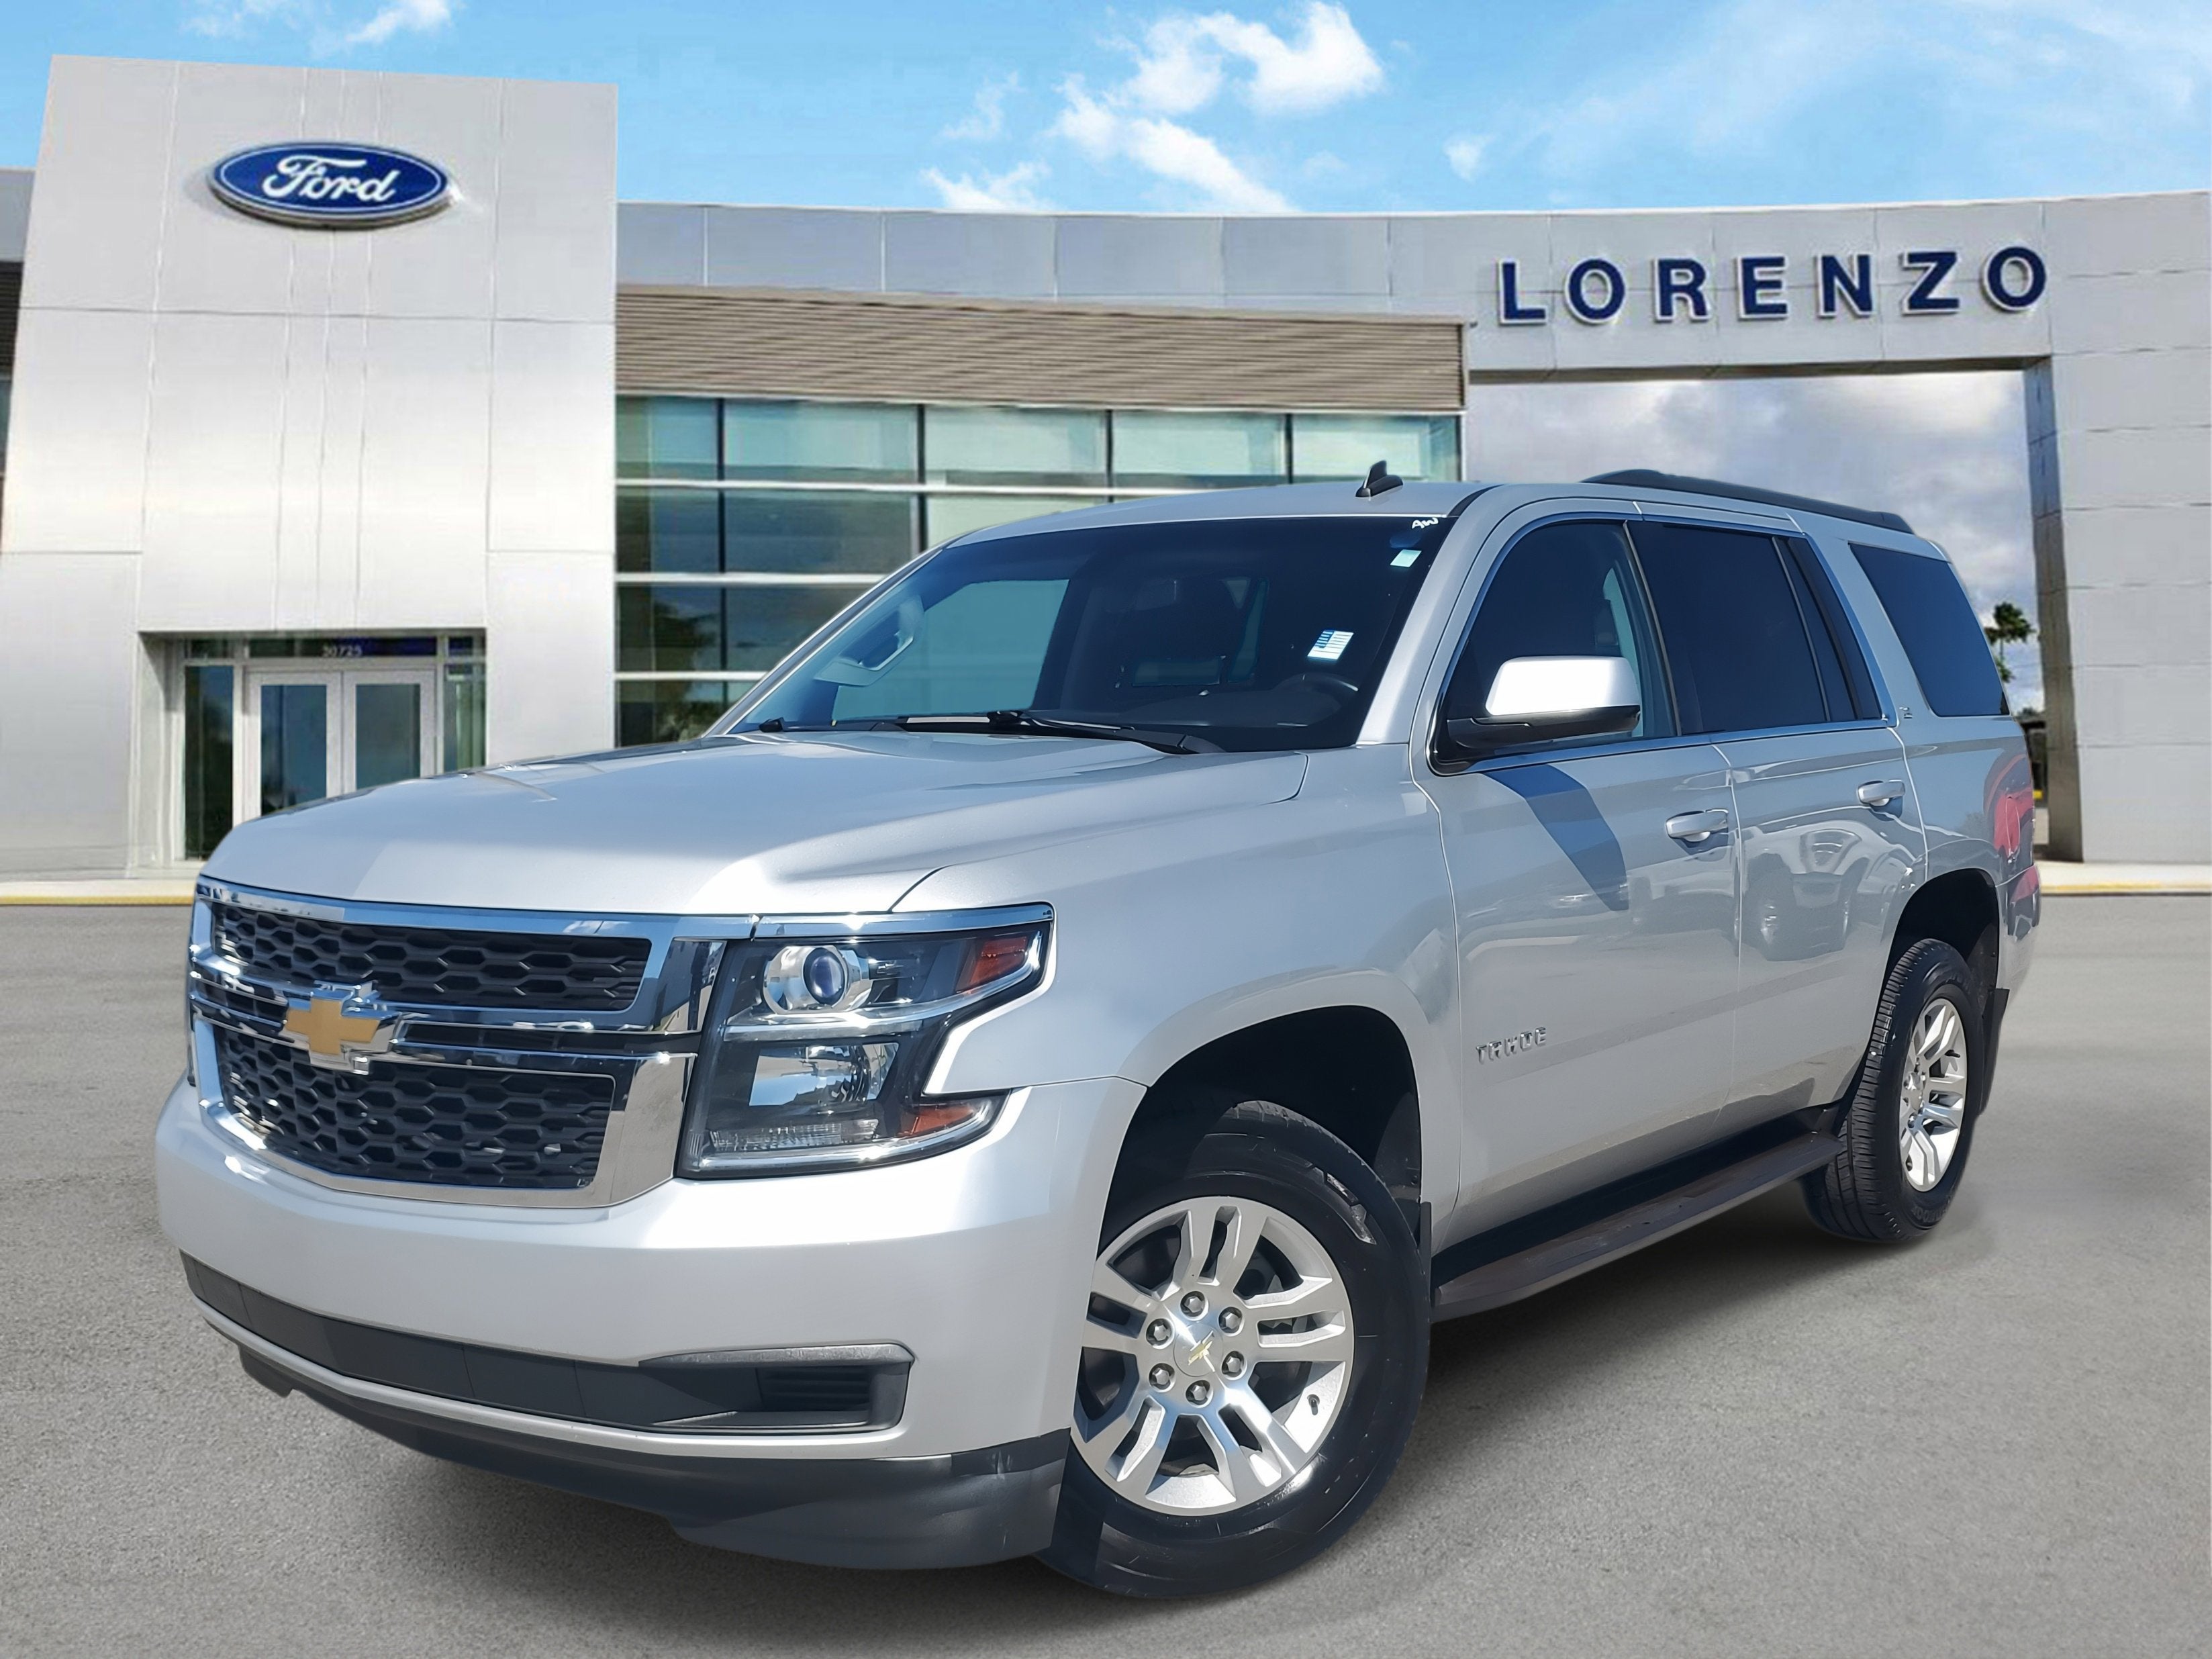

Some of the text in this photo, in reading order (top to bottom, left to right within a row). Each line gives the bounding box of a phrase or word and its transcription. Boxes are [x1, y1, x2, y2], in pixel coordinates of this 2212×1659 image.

[262, 154, 400, 201] Ford
[1497, 246, 2046, 324] LORENZO
[1476, 1027, 1546, 1064] TAHOE
